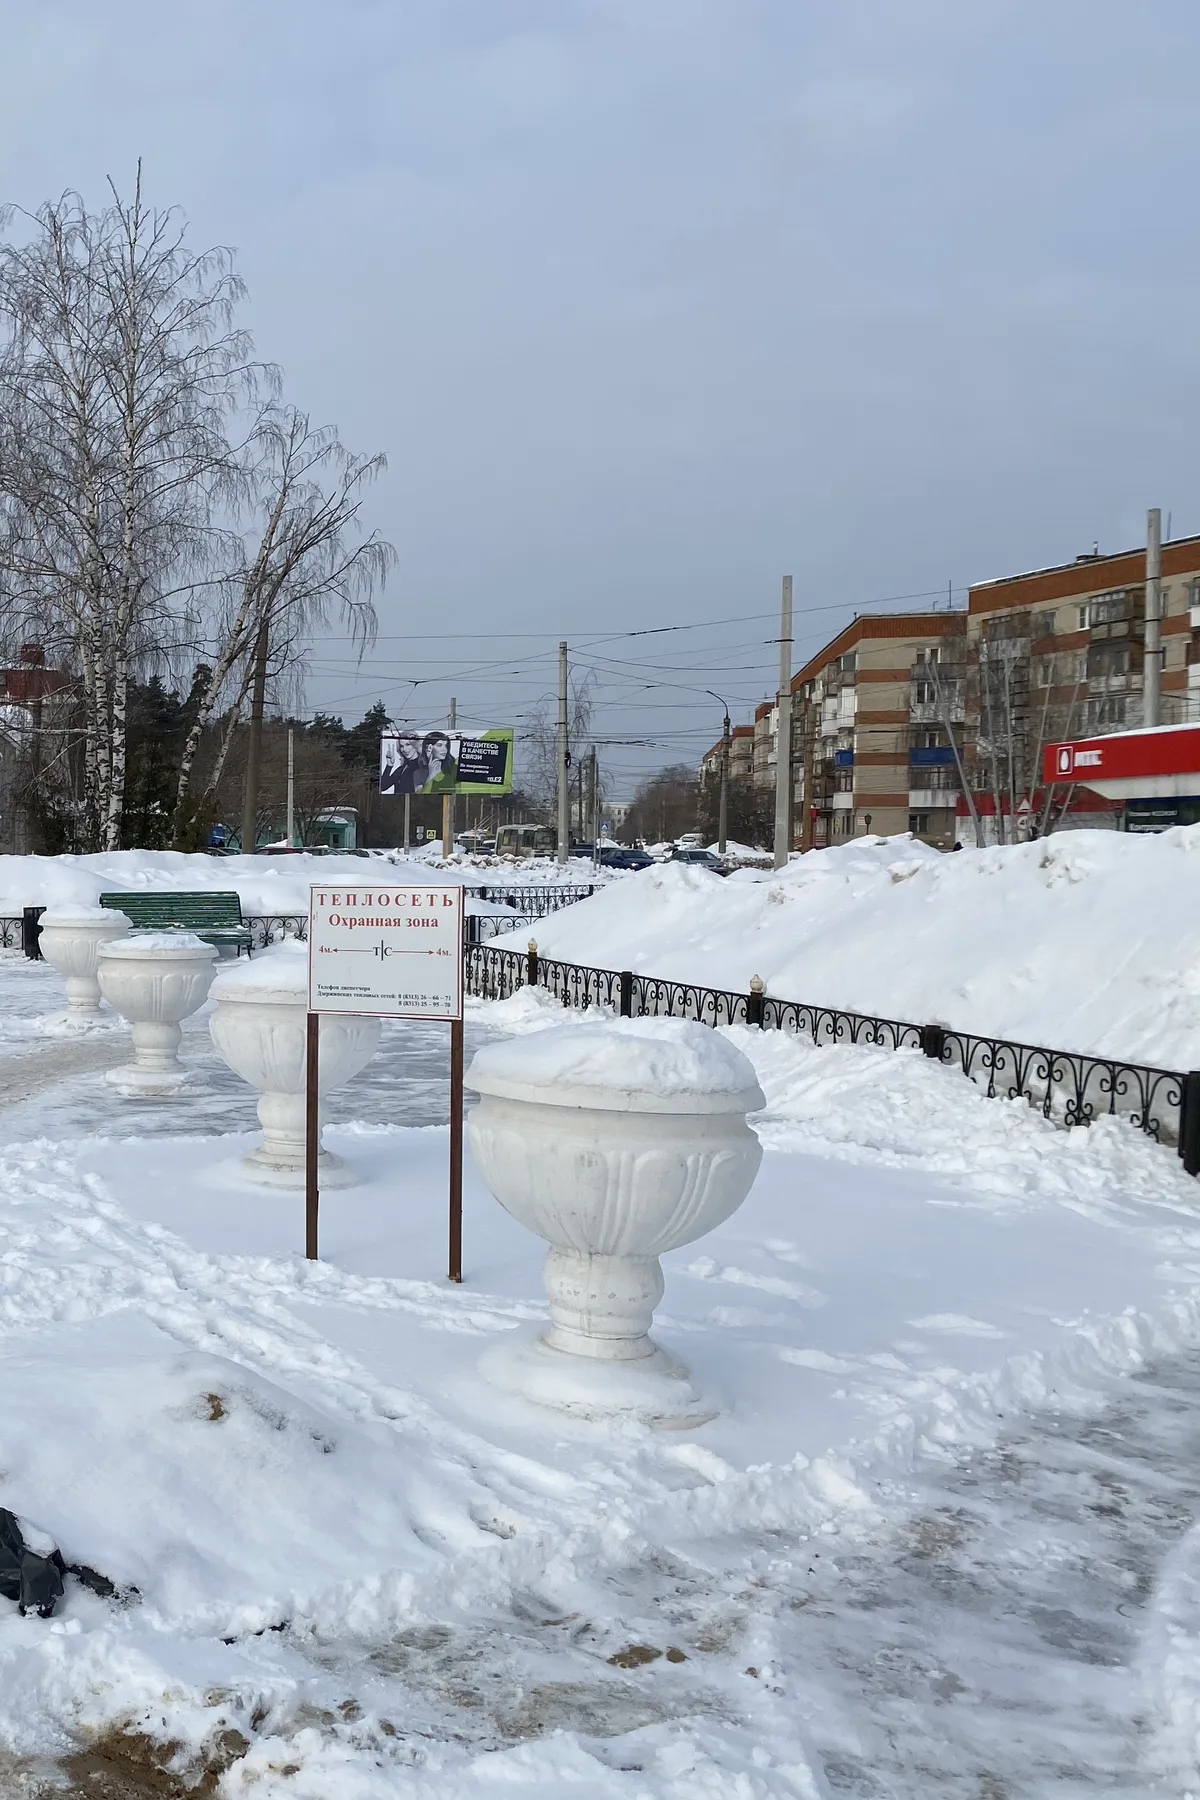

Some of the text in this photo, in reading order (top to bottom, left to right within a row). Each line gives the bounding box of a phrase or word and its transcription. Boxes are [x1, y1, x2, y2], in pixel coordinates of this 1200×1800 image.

[463, 741, 498, 749] УБЕДИТЕСЬ
[468, 747, 499, 755] КАЧЕСТВЕ
[317, 893, 454, 907] ТЕПЛОСЕТЬ
[328, 913, 440, 930] Охранная зона
[318, 945, 334, 954] 4м.
[436, 947, 453, 957] 4м.
